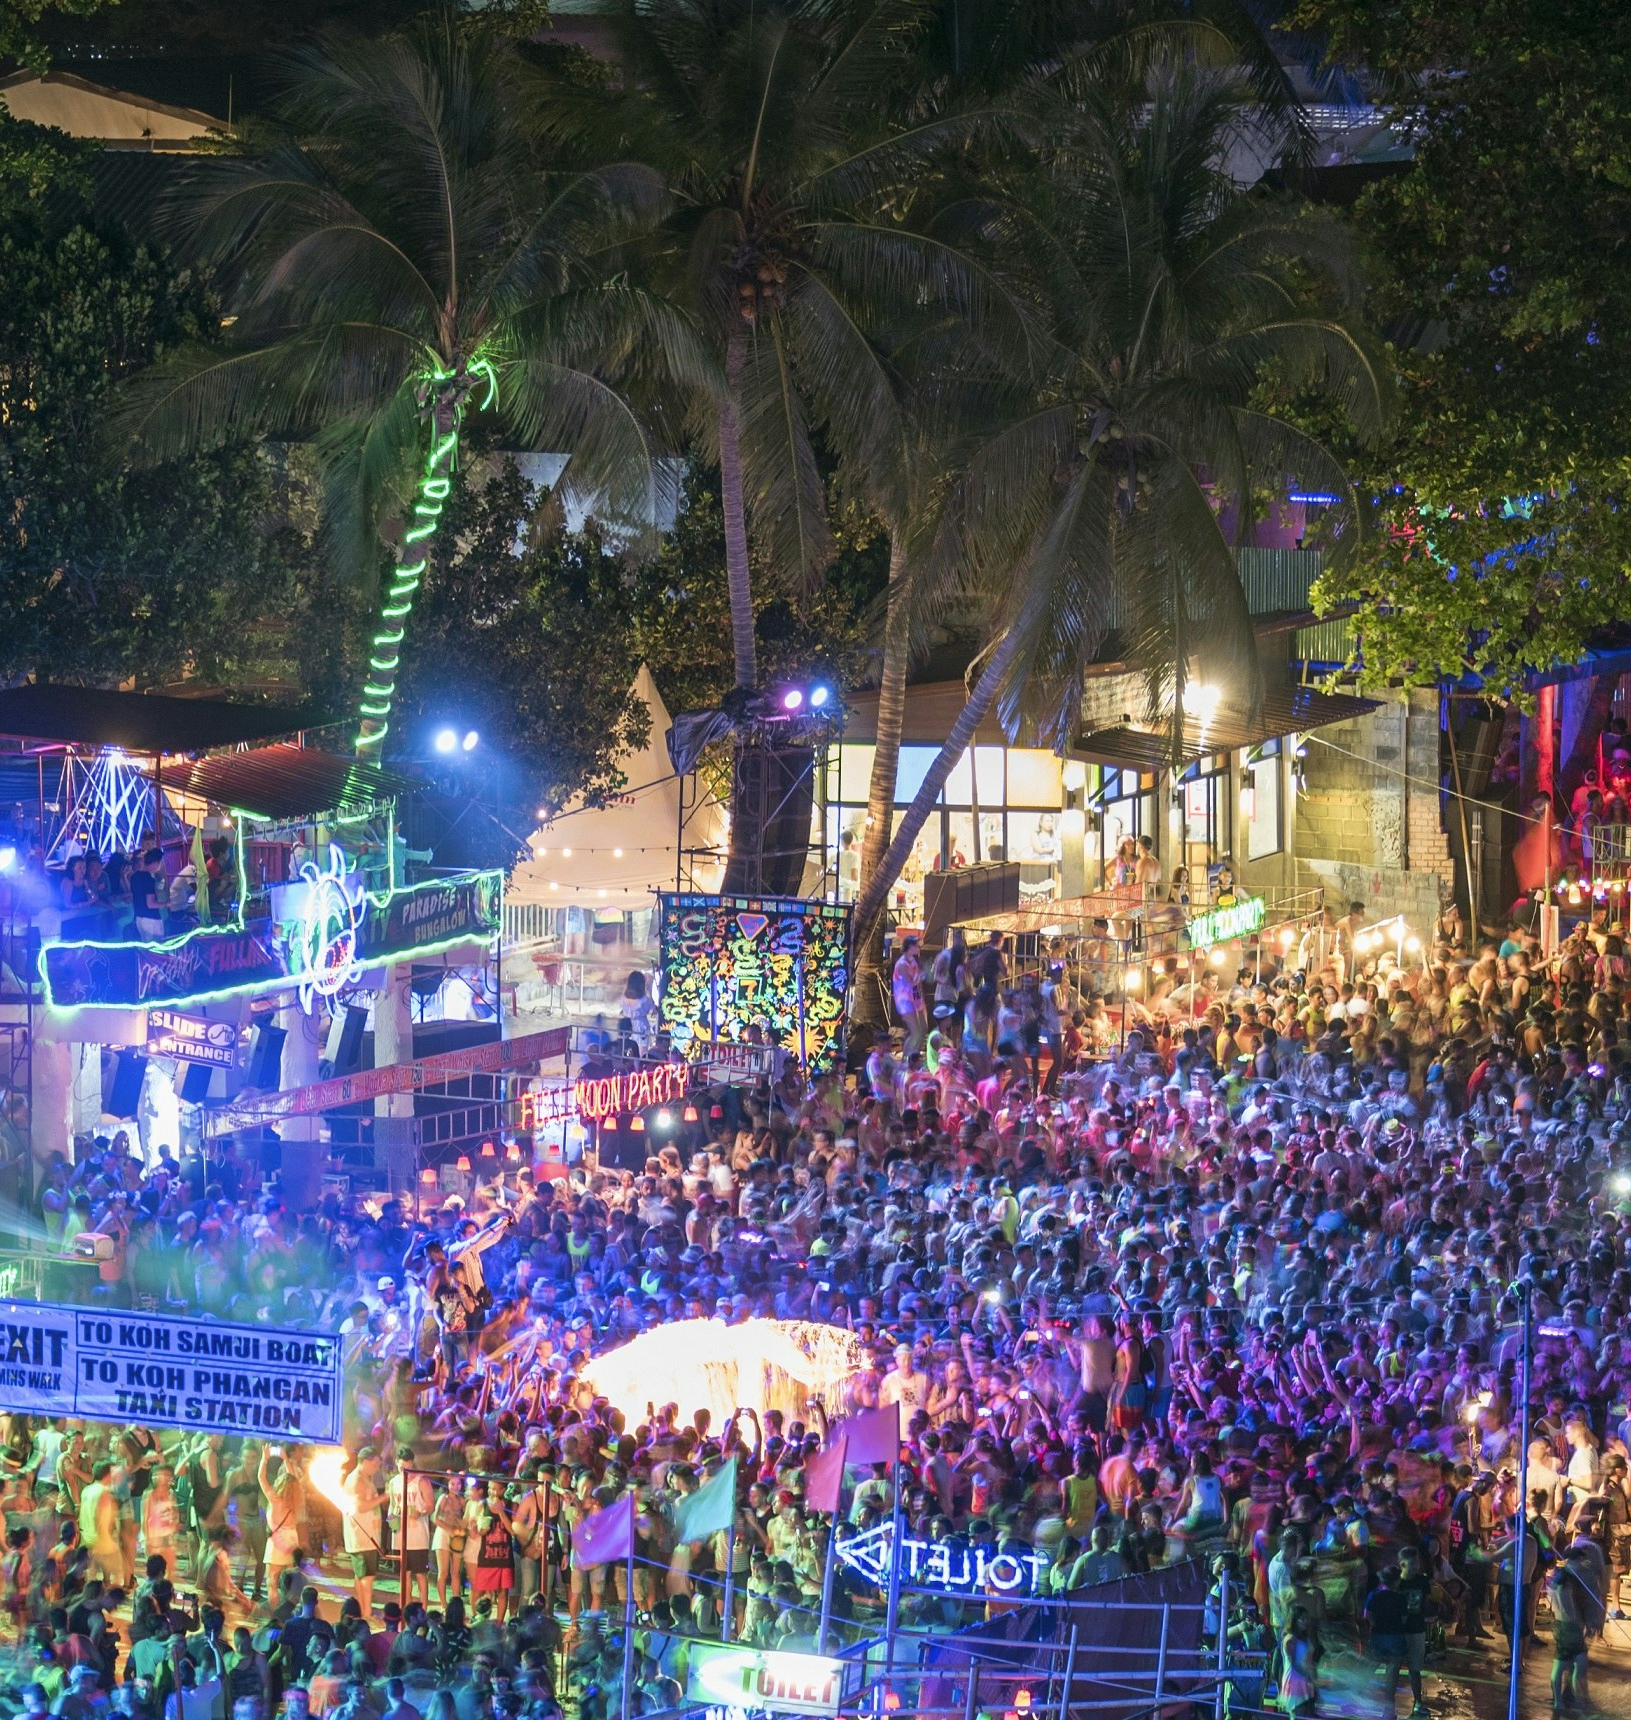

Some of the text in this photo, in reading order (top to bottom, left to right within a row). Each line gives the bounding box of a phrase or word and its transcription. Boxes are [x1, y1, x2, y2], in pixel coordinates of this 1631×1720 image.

[402, 886, 457, 925] PARADISE
[414, 907, 467, 944] BUNGALOW
[152, 1011, 206, 1040] SLIDE
[342, 1079, 351, 1100] 60
[573, 1074, 621, 1118] MOON
[627, 1062, 689, 1111] PARTY
[80, 1320, 332, 1367] TO KOH SAMUI BOAT
[28, 1372, 62, 1391] WALK
[81, 1357, 332, 1407] TO KOH PHANGAN
[115, 1389, 302, 1430] TAXI STATION
[740, 1666, 838, 1704] TOILET
